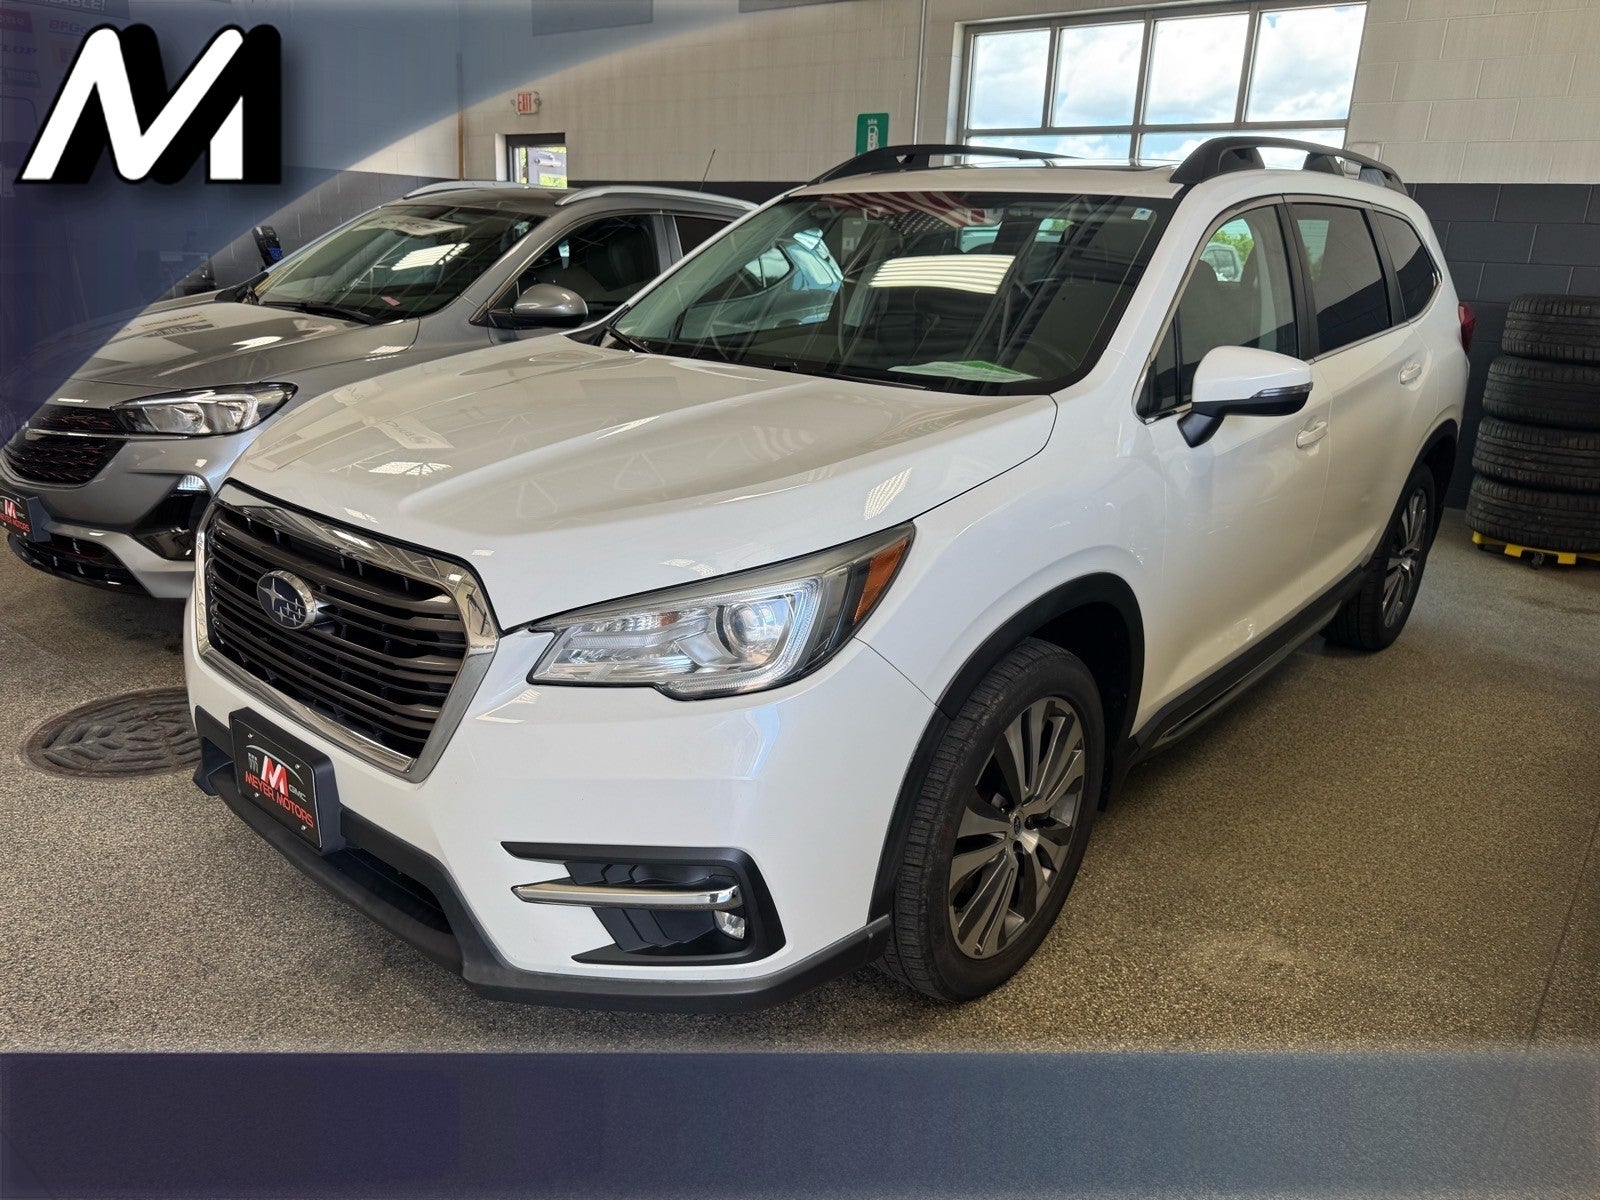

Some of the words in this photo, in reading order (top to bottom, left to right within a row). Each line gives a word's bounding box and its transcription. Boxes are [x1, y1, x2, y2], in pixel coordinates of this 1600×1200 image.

[517, 93, 532, 112] EXIT
[245, 770, 275, 801] MEYER
[276, 792, 314, 828] MOTORS
[288, 784, 307, 803] GMC
